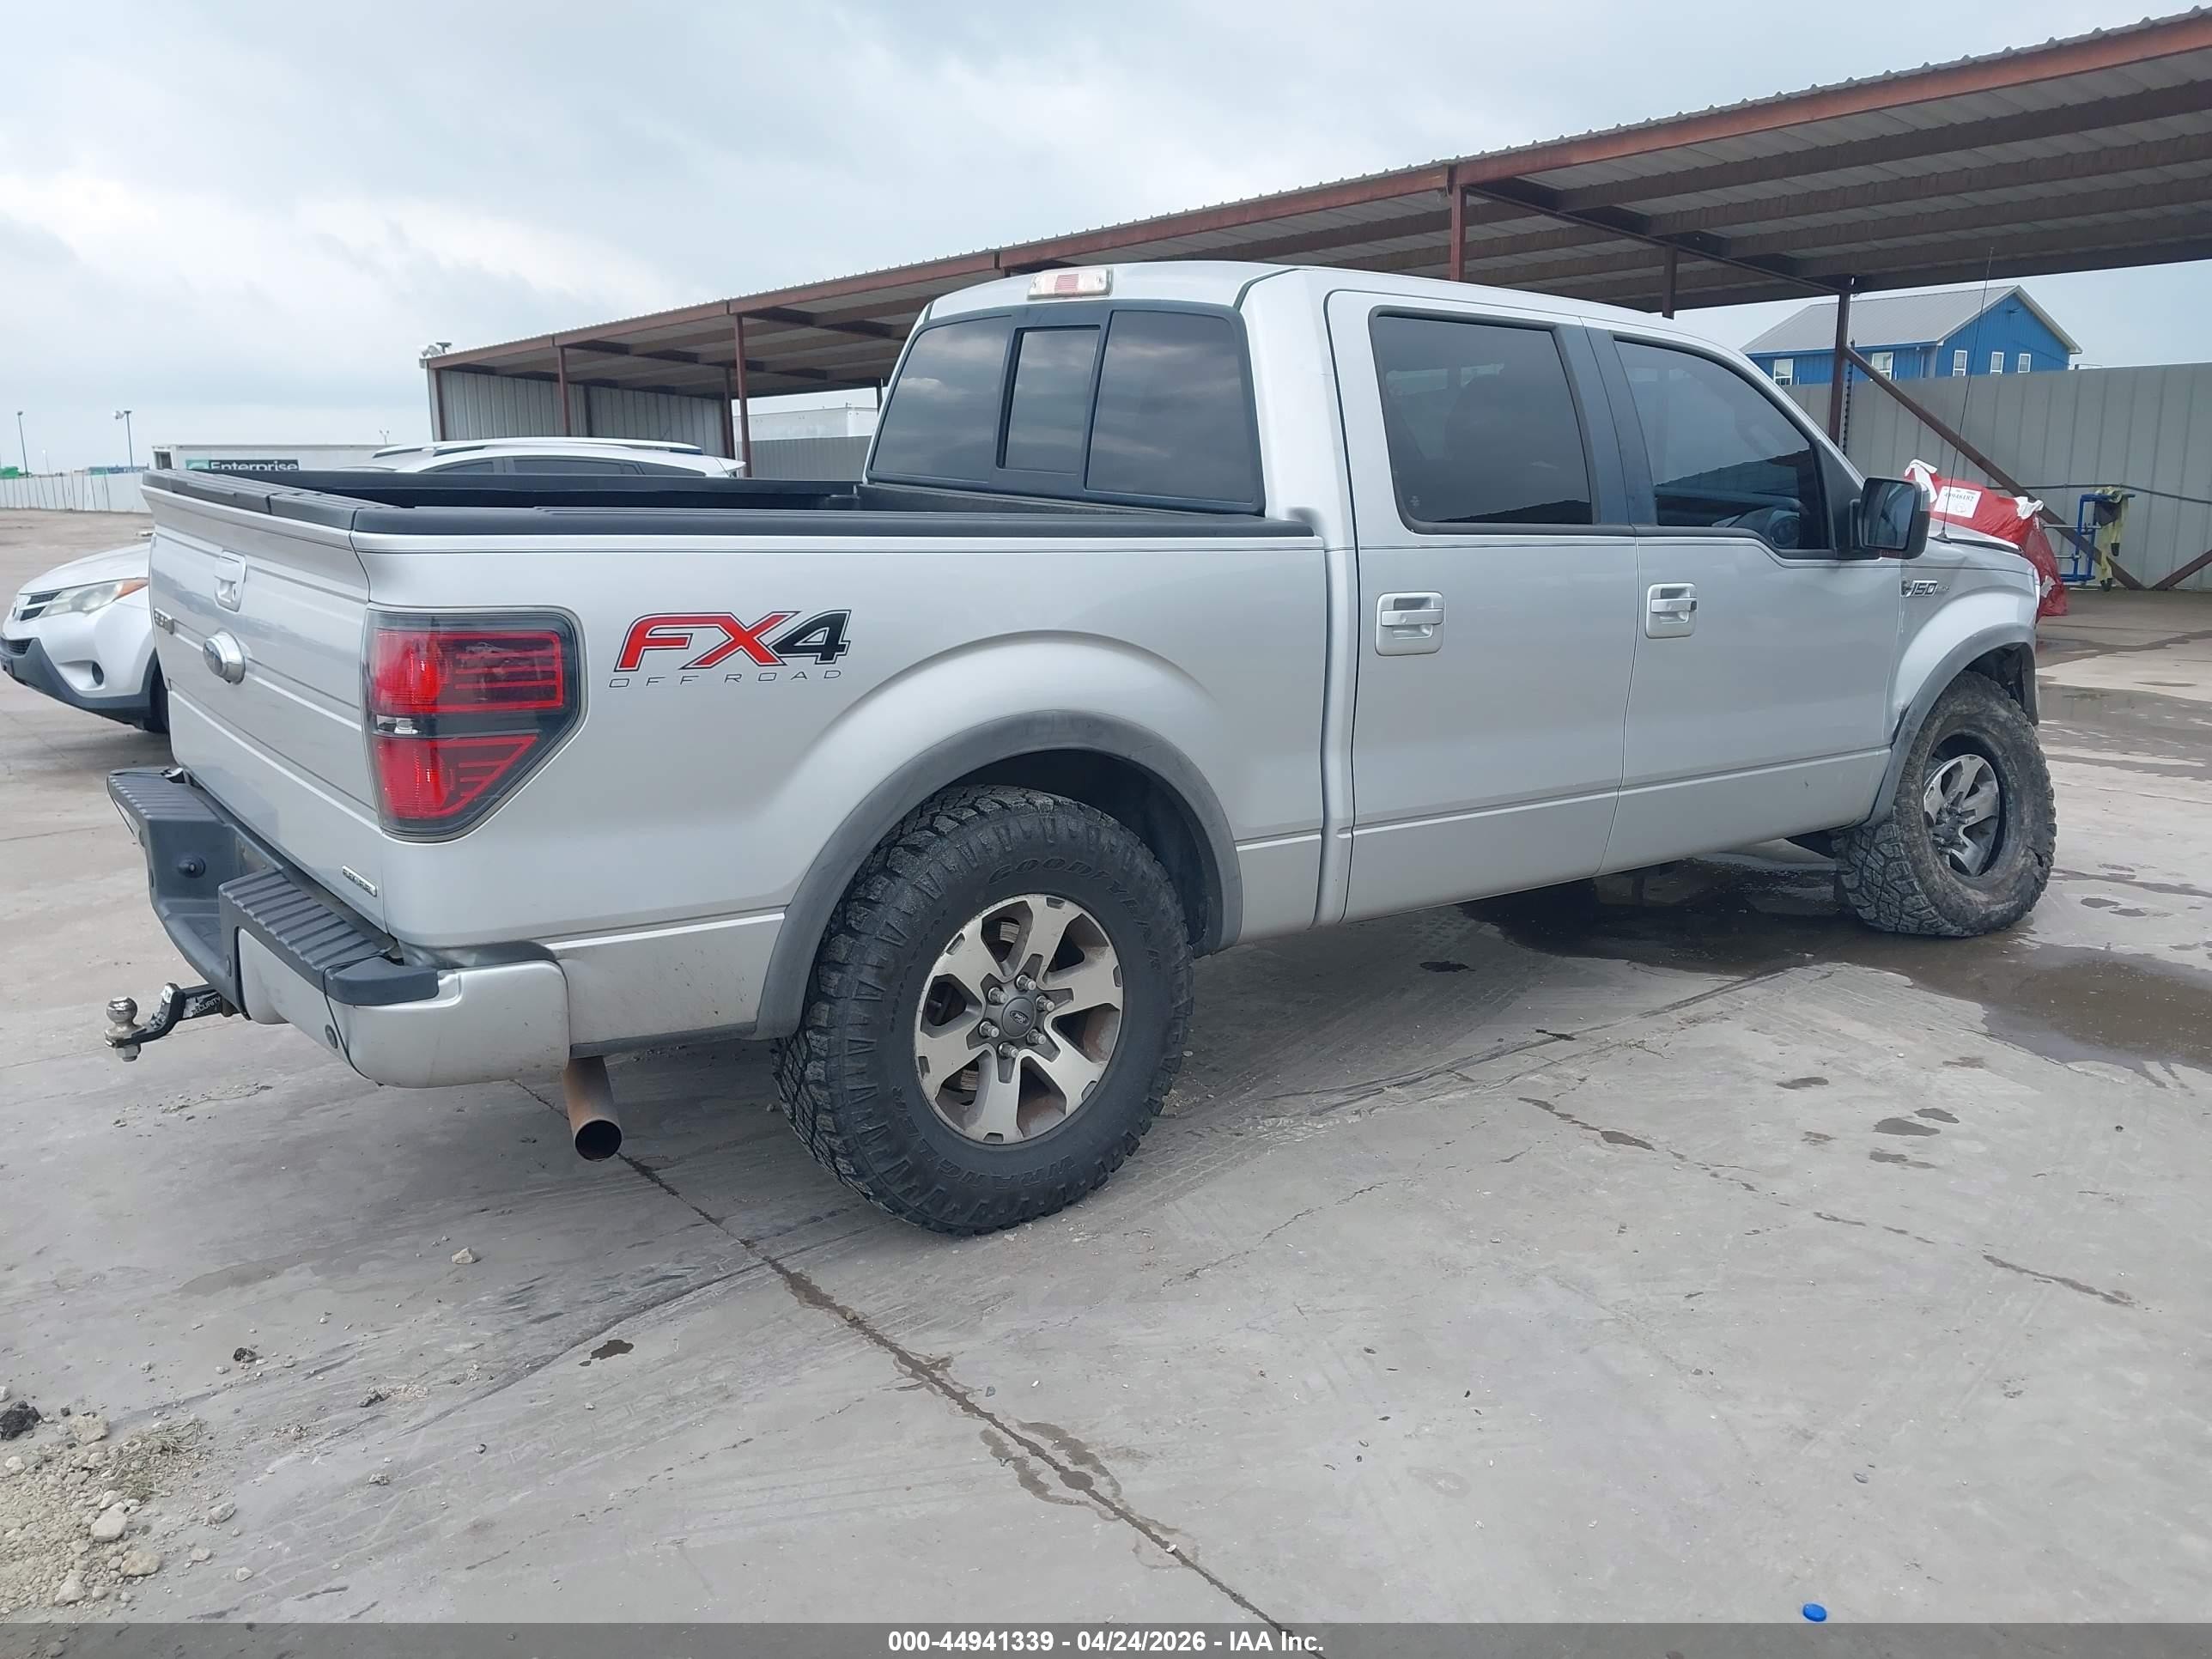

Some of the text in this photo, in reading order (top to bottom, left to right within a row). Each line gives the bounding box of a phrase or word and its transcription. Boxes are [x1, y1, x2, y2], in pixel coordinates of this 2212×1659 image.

[210, 459, 299, 471] Enterprise
[613, 609, 852, 672] FX4
[609, 670, 842, 688] OFF ROAD
